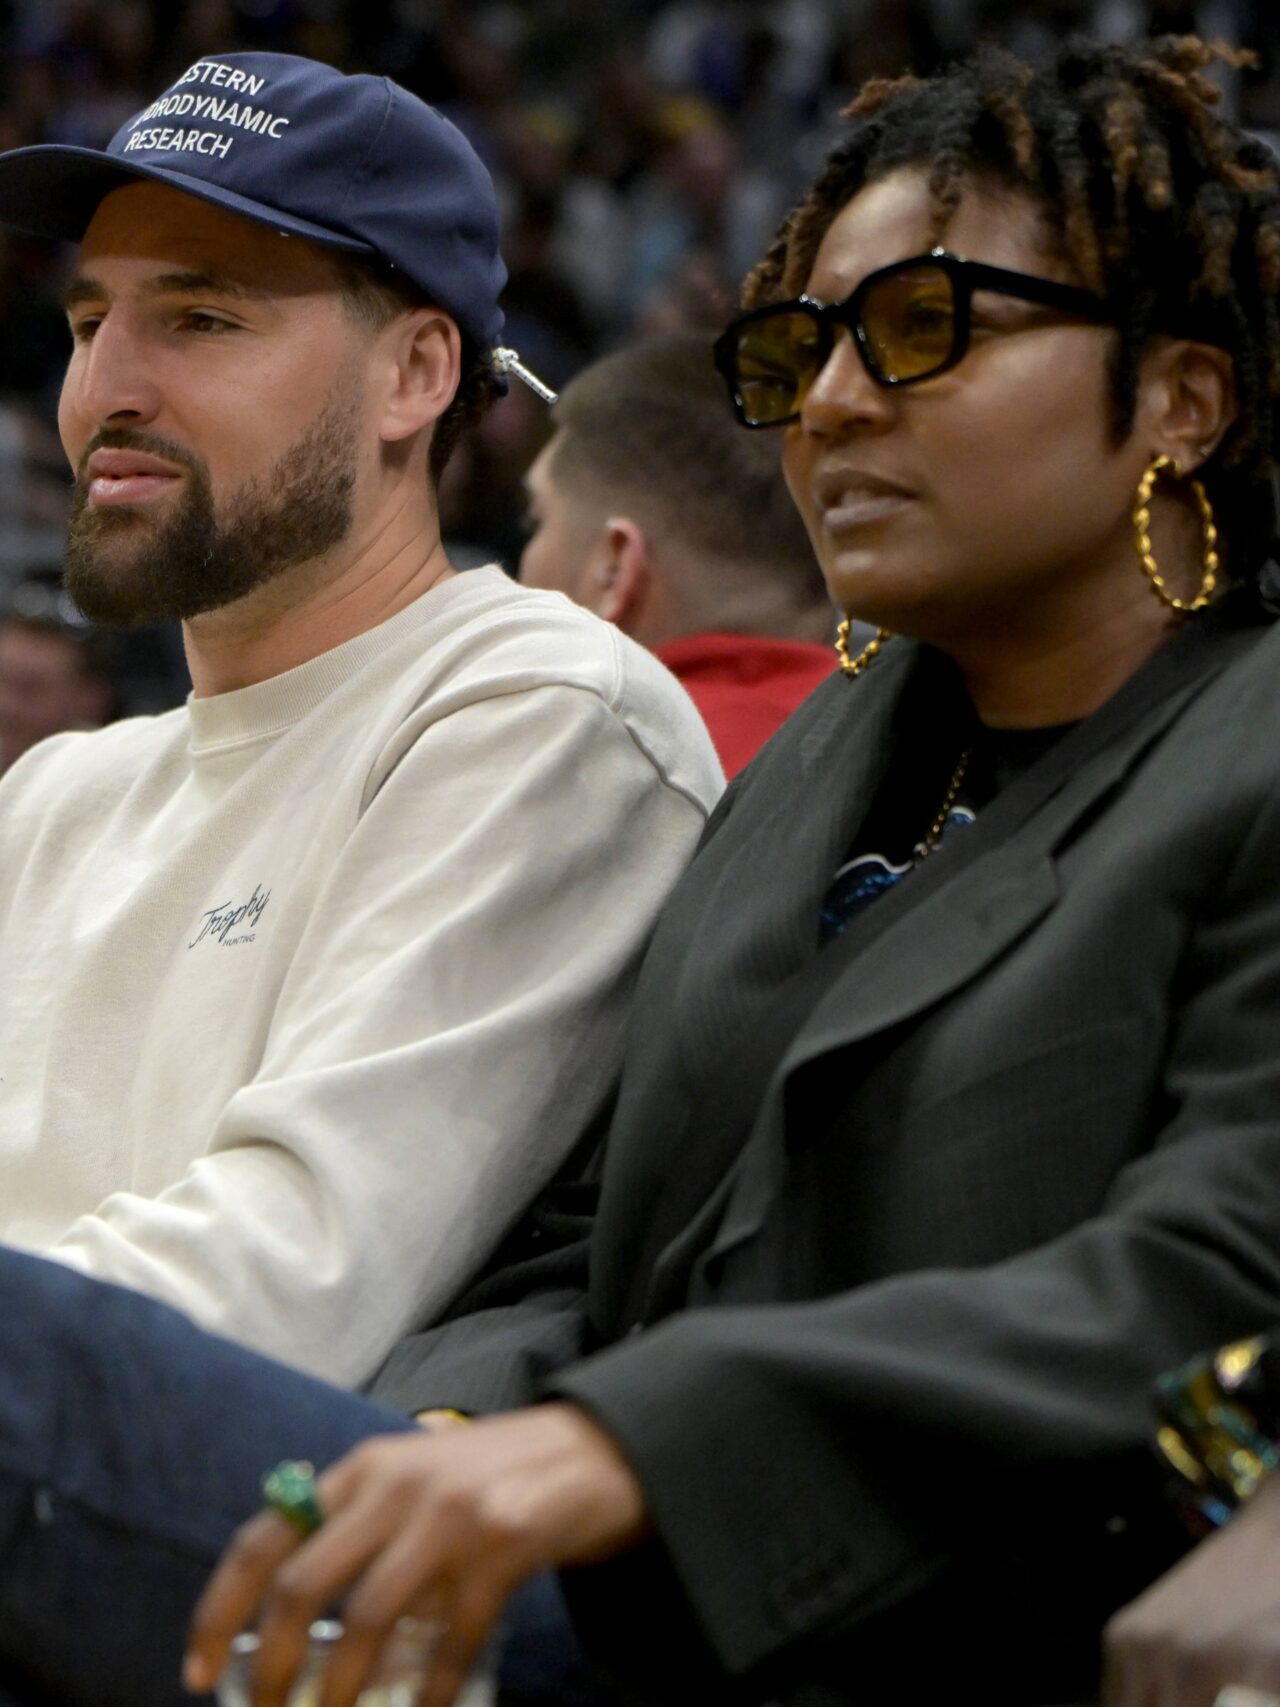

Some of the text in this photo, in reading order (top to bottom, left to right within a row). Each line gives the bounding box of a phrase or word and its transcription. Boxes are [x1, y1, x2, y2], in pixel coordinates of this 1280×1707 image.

[127, 94, 289, 138] DRODYNAMIC
[124, 128, 233, 159] RESEARCH
[188, 883, 272, 948] Trophy
